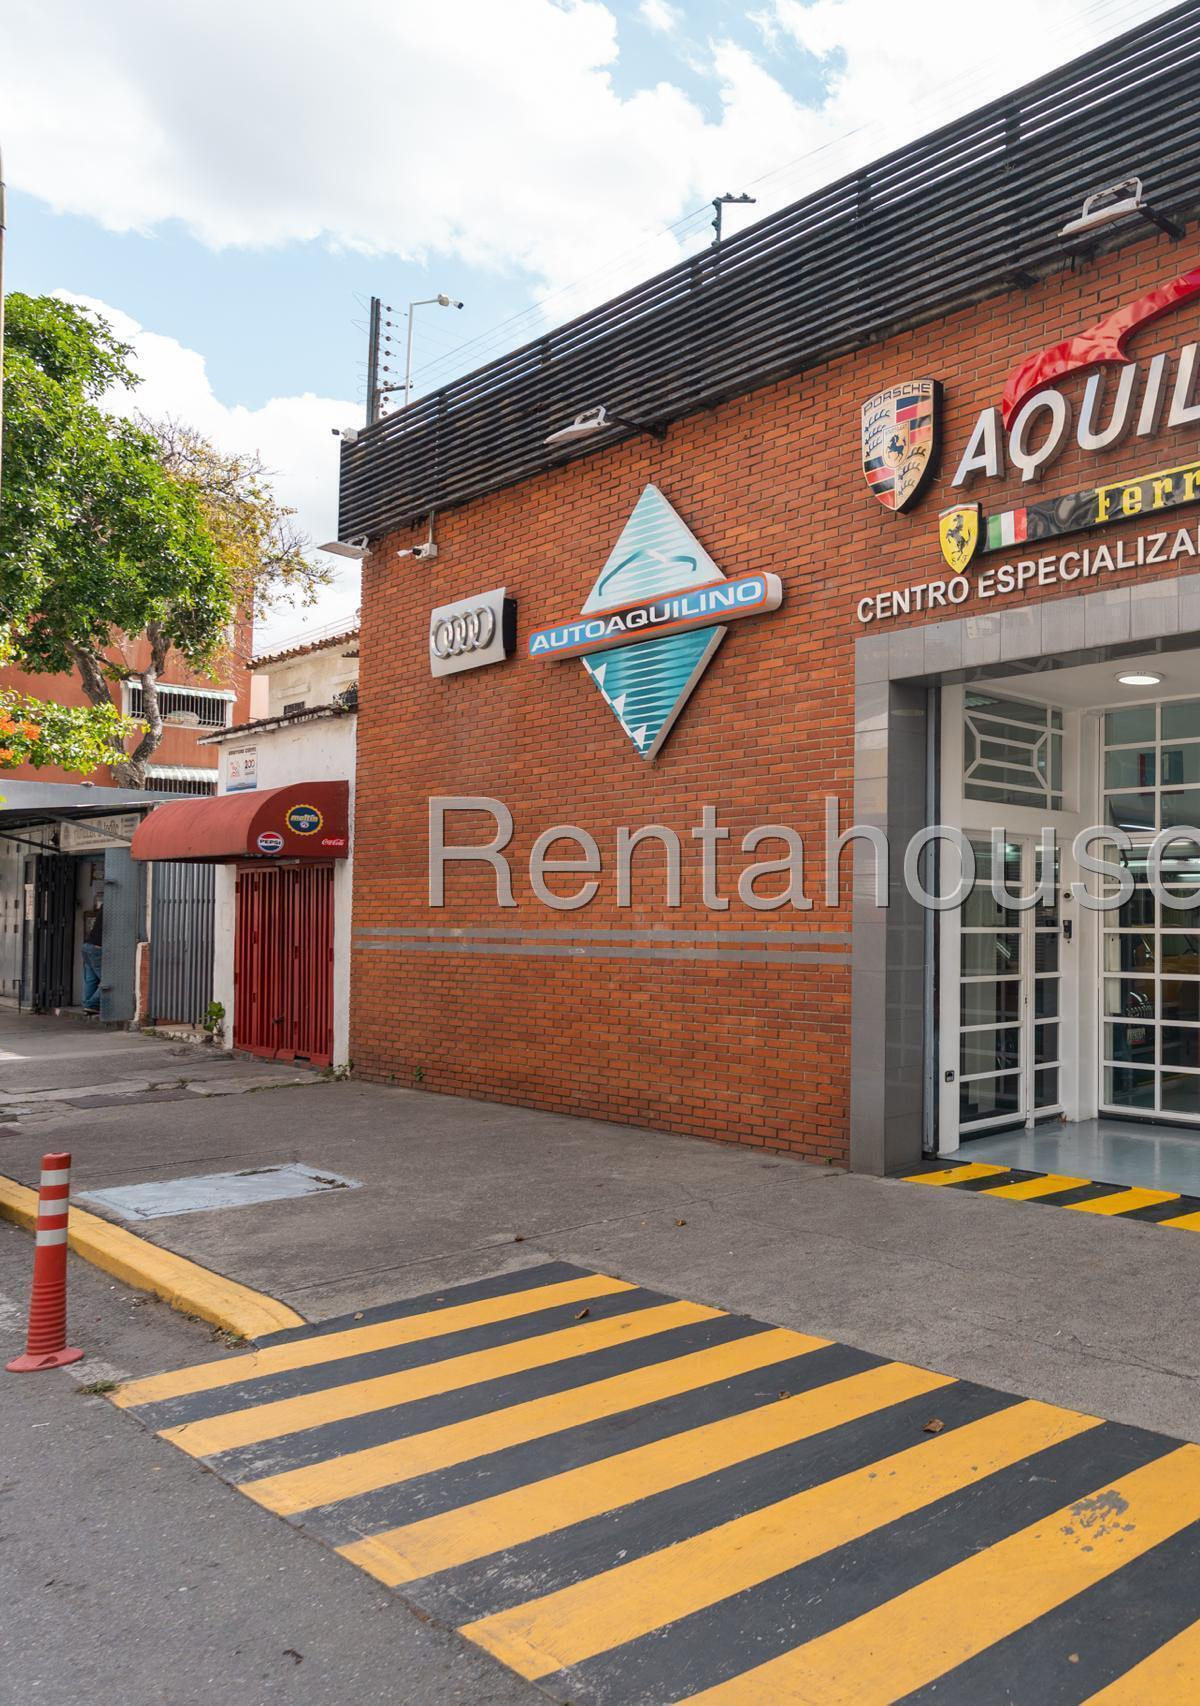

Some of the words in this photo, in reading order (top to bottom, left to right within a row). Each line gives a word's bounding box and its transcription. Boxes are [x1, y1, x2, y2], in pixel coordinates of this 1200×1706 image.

[863, 383, 931, 416] PORSCHE
[530, 581, 763, 653] AUTOAQUILINO
[857, 577, 969, 623] CENTRO
